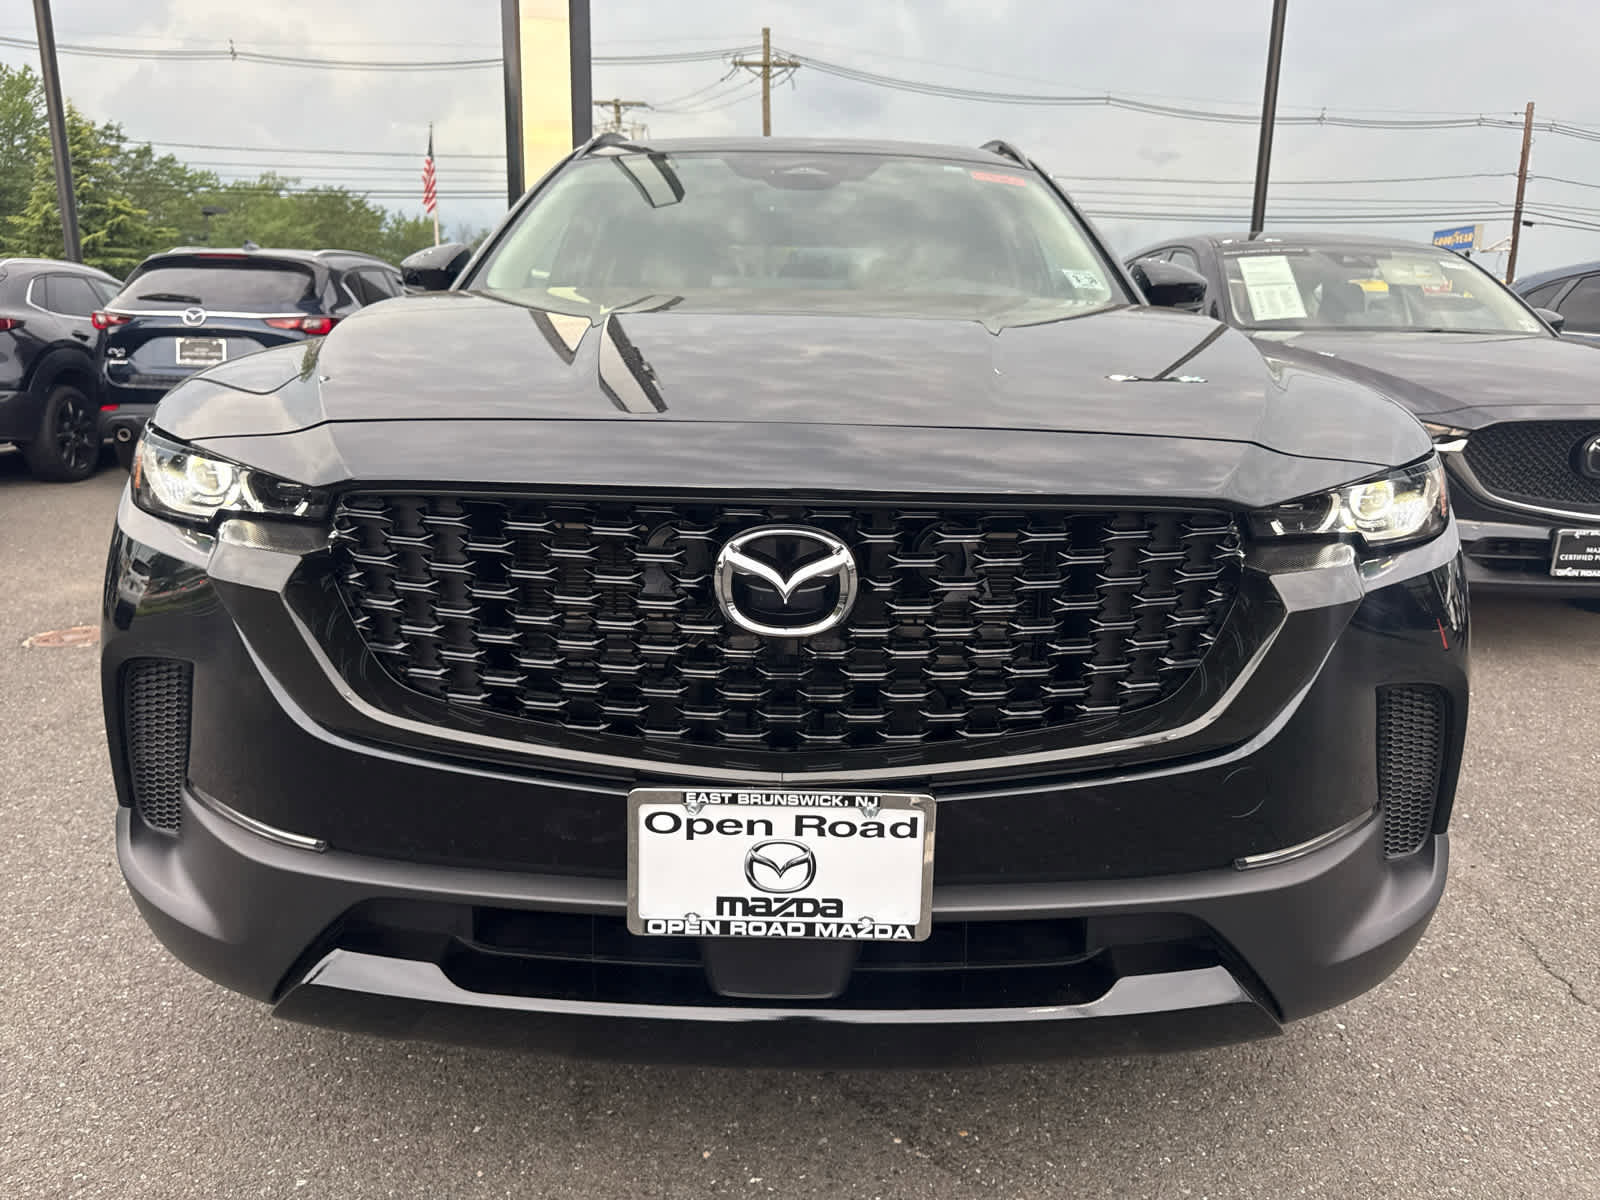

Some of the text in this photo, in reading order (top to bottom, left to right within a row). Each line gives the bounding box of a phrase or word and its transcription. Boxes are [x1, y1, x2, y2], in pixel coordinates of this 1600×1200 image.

[686, 792, 878, 807] EAST BRUNSWICK, NJ
[645, 811, 918, 840] Open Road
[647, 920, 912, 939] OPEN ROAD MAZDA
